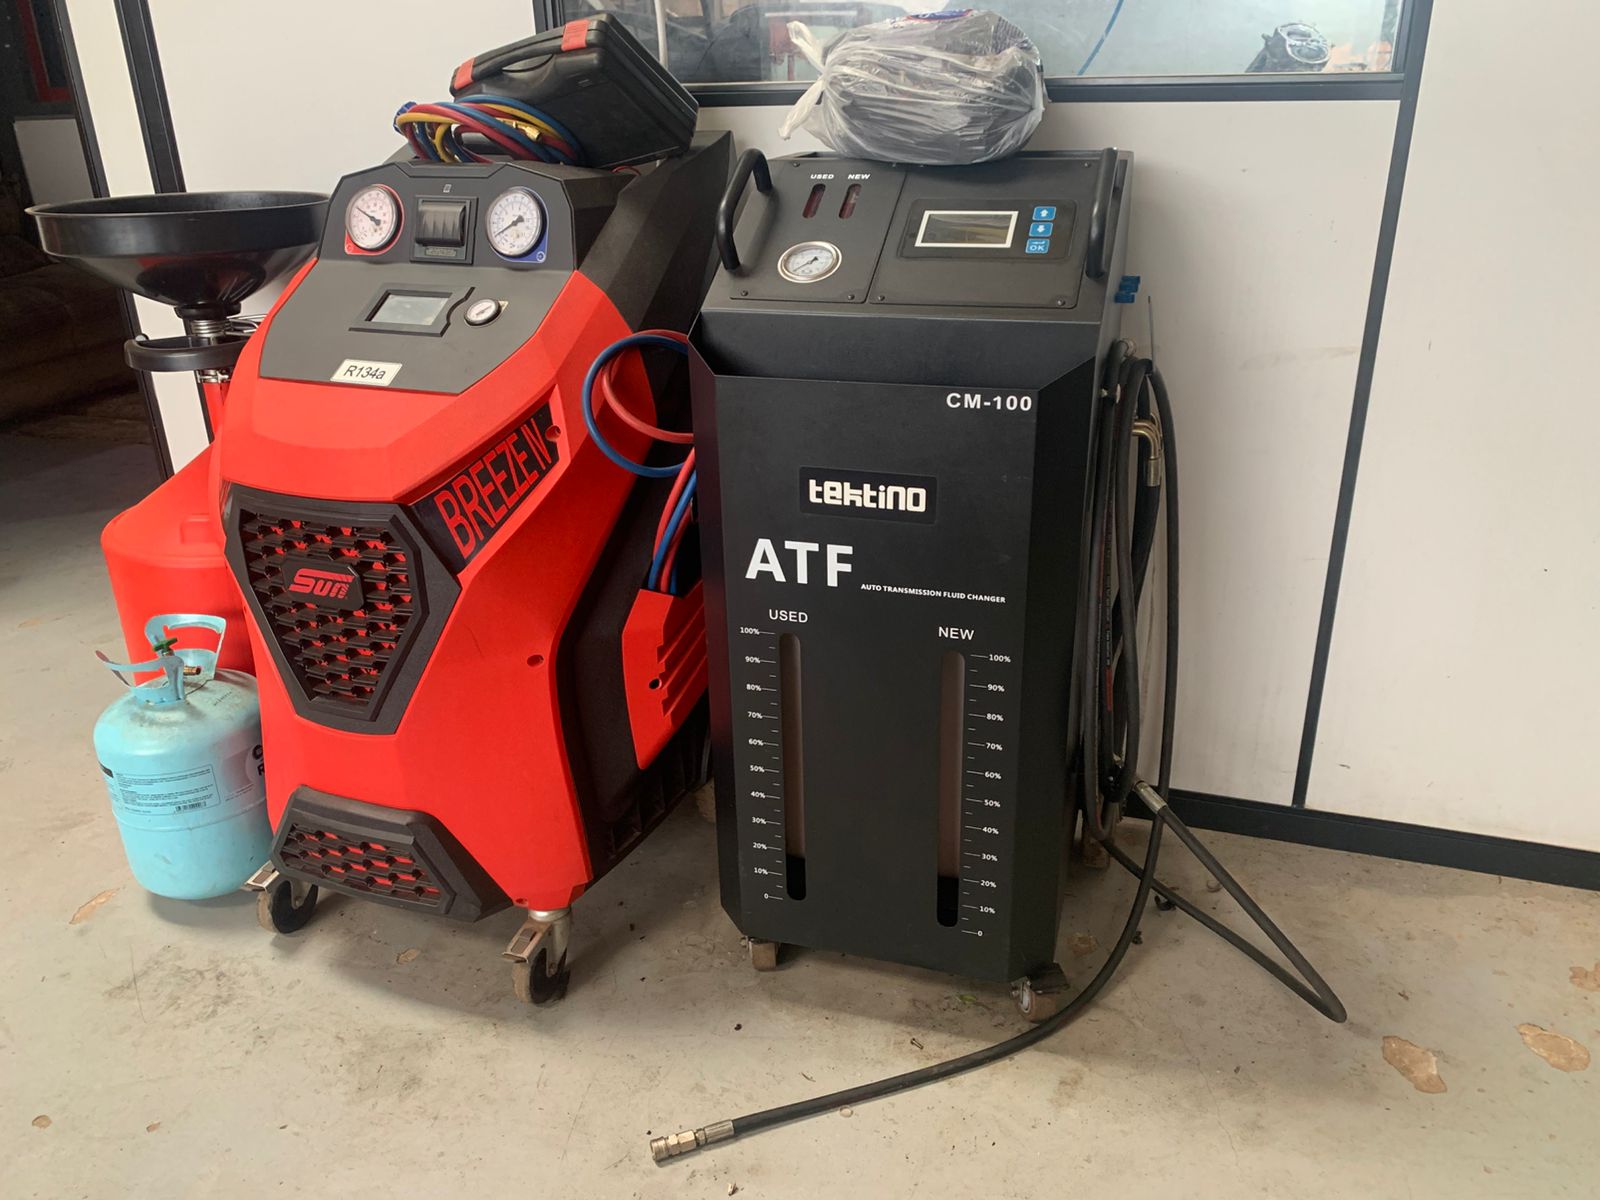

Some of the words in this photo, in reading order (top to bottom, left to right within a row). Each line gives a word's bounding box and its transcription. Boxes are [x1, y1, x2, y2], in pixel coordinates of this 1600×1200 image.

[343, 365, 386, 379] R134a
[946, 392, 1033, 412] CM-100
[434, 432, 540, 559] BREEZE
[745, 538, 853, 587] ATF
[288, 568, 355, 599] Sun
[860, 583, 882, 591] AUTO
[883, 585, 942, 597] TRANSMISSION
[943, 591, 966, 599] FLUID
[967, 593, 1006, 604] CHANGER
[768, 608, 808, 623] USED
[740, 626, 760, 635] 100%
[938, 626, 975, 640] NEW
[745, 655, 761, 664] 90%
[989, 654, 1011, 663] 100%
[746, 683, 762, 692] 80%
[987, 683, 1005, 692] 90%
[747, 711, 763, 720] 70%
[986, 713, 1004, 722] 80%
[748, 738, 764, 746] 60%
[985, 742, 1003, 752] 70%
[749, 764, 765, 773] 50%
[984, 771, 1002, 780] 60%
[750, 790, 766, 799] 40%
[984, 799, 1001, 808] 50%
[751, 816, 767, 825] 30%
[982, 826, 999, 835] 40%
[752, 841, 768, 850] 20%
[981, 853, 998, 862] 30%
[753, 866, 769, 875] 10%
[980, 879, 997, 888] 20%
[979, 905, 996, 914] 10%
